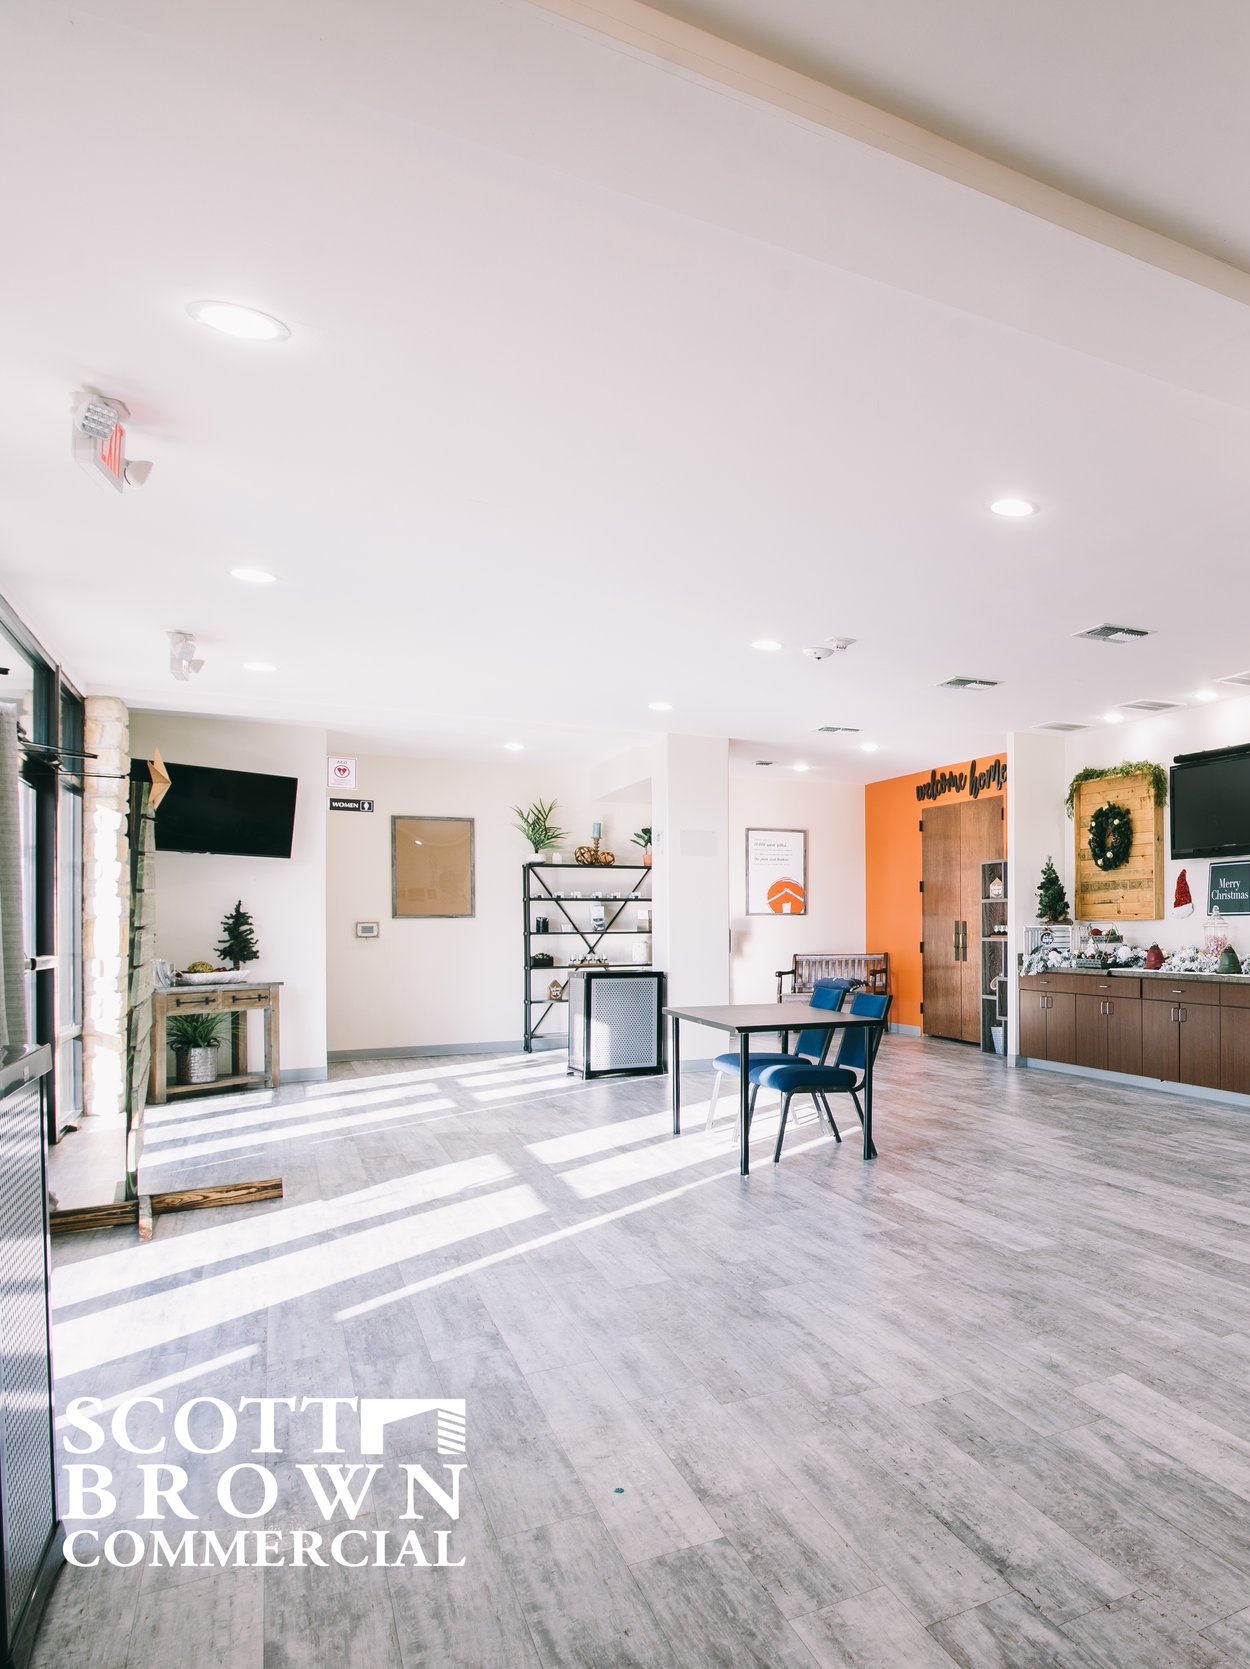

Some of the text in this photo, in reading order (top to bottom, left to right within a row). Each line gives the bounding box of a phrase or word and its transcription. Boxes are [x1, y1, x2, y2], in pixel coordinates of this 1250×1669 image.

[916, 759, 1007, 801] welcome home
[1218, 878, 1241, 891] Merry
[1211, 889, 1249, 900] Christmas
